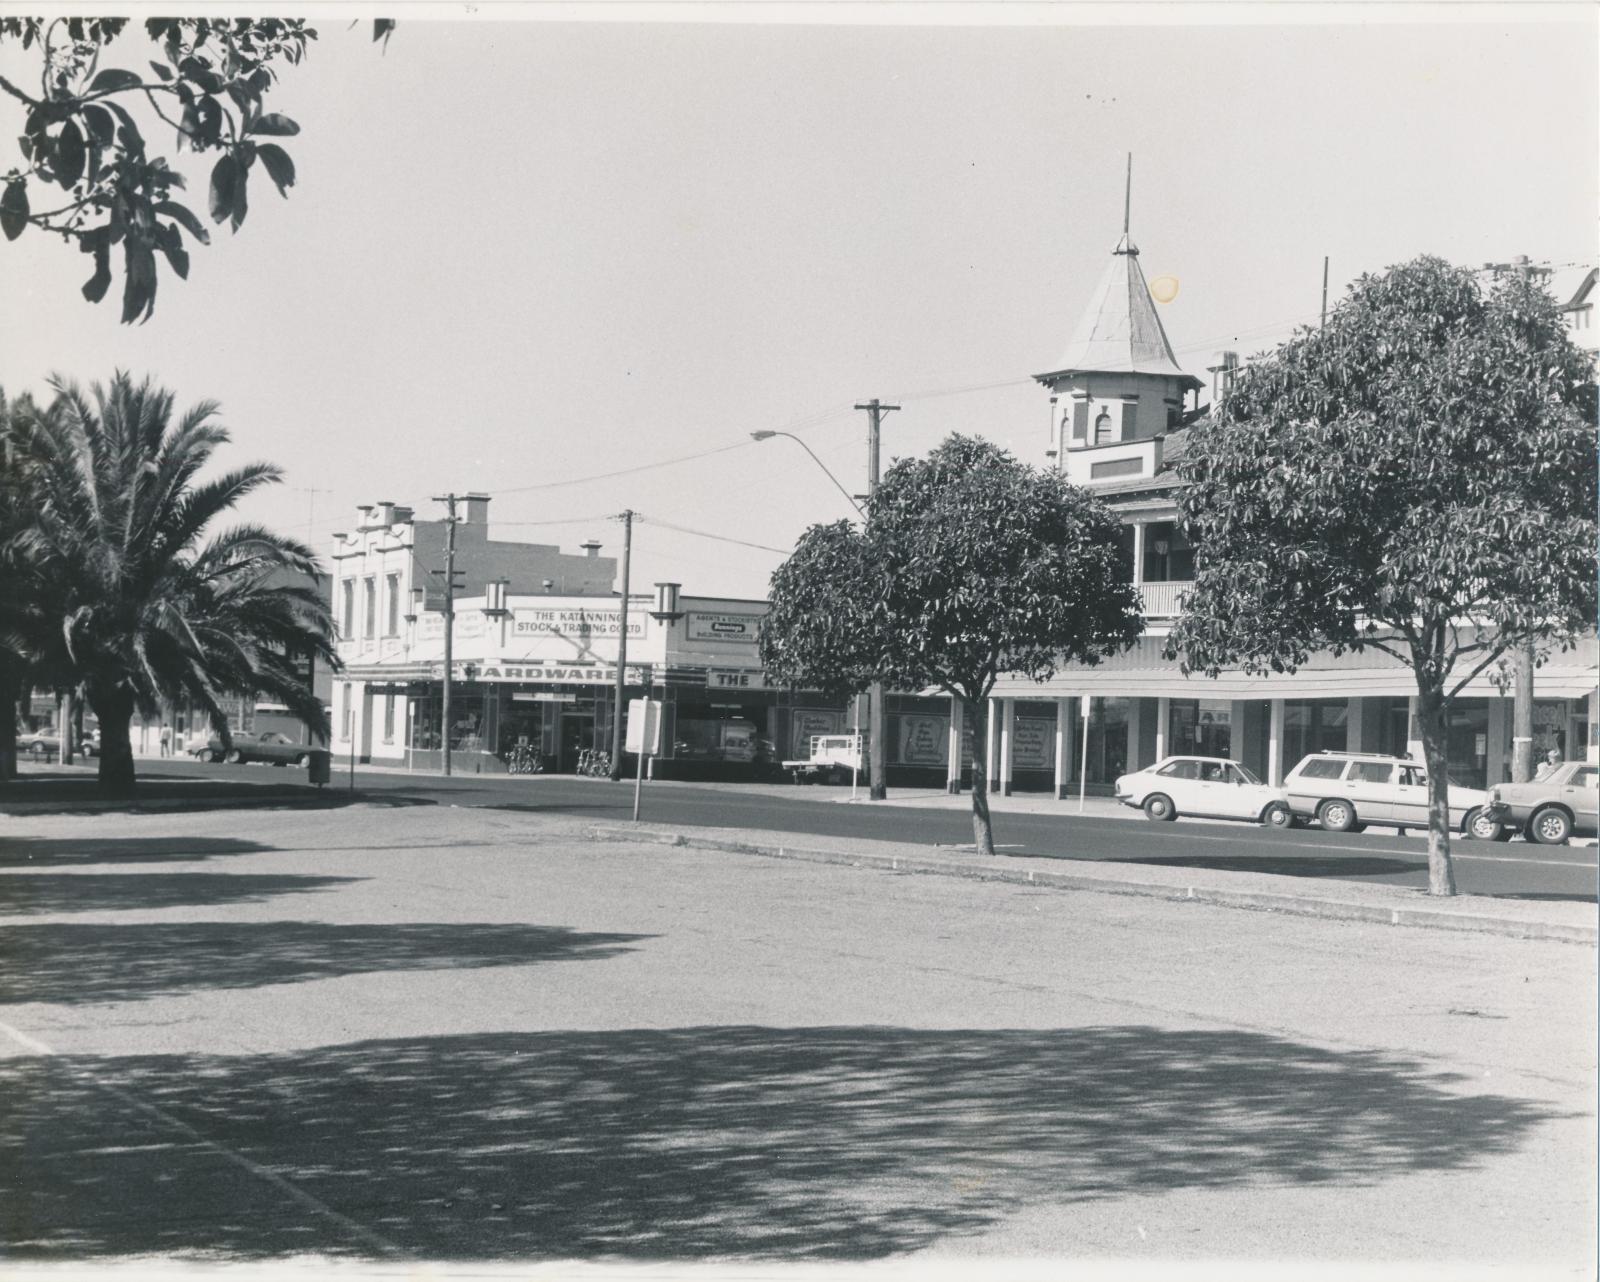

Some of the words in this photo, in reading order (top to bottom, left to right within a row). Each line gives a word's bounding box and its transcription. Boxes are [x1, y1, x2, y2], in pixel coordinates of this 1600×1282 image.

[535, 612, 555, 621] THE
[517, 622, 552, 632] STOCK
[562, 623, 607, 632] TRADING
[716, 674, 749, 687] THE
